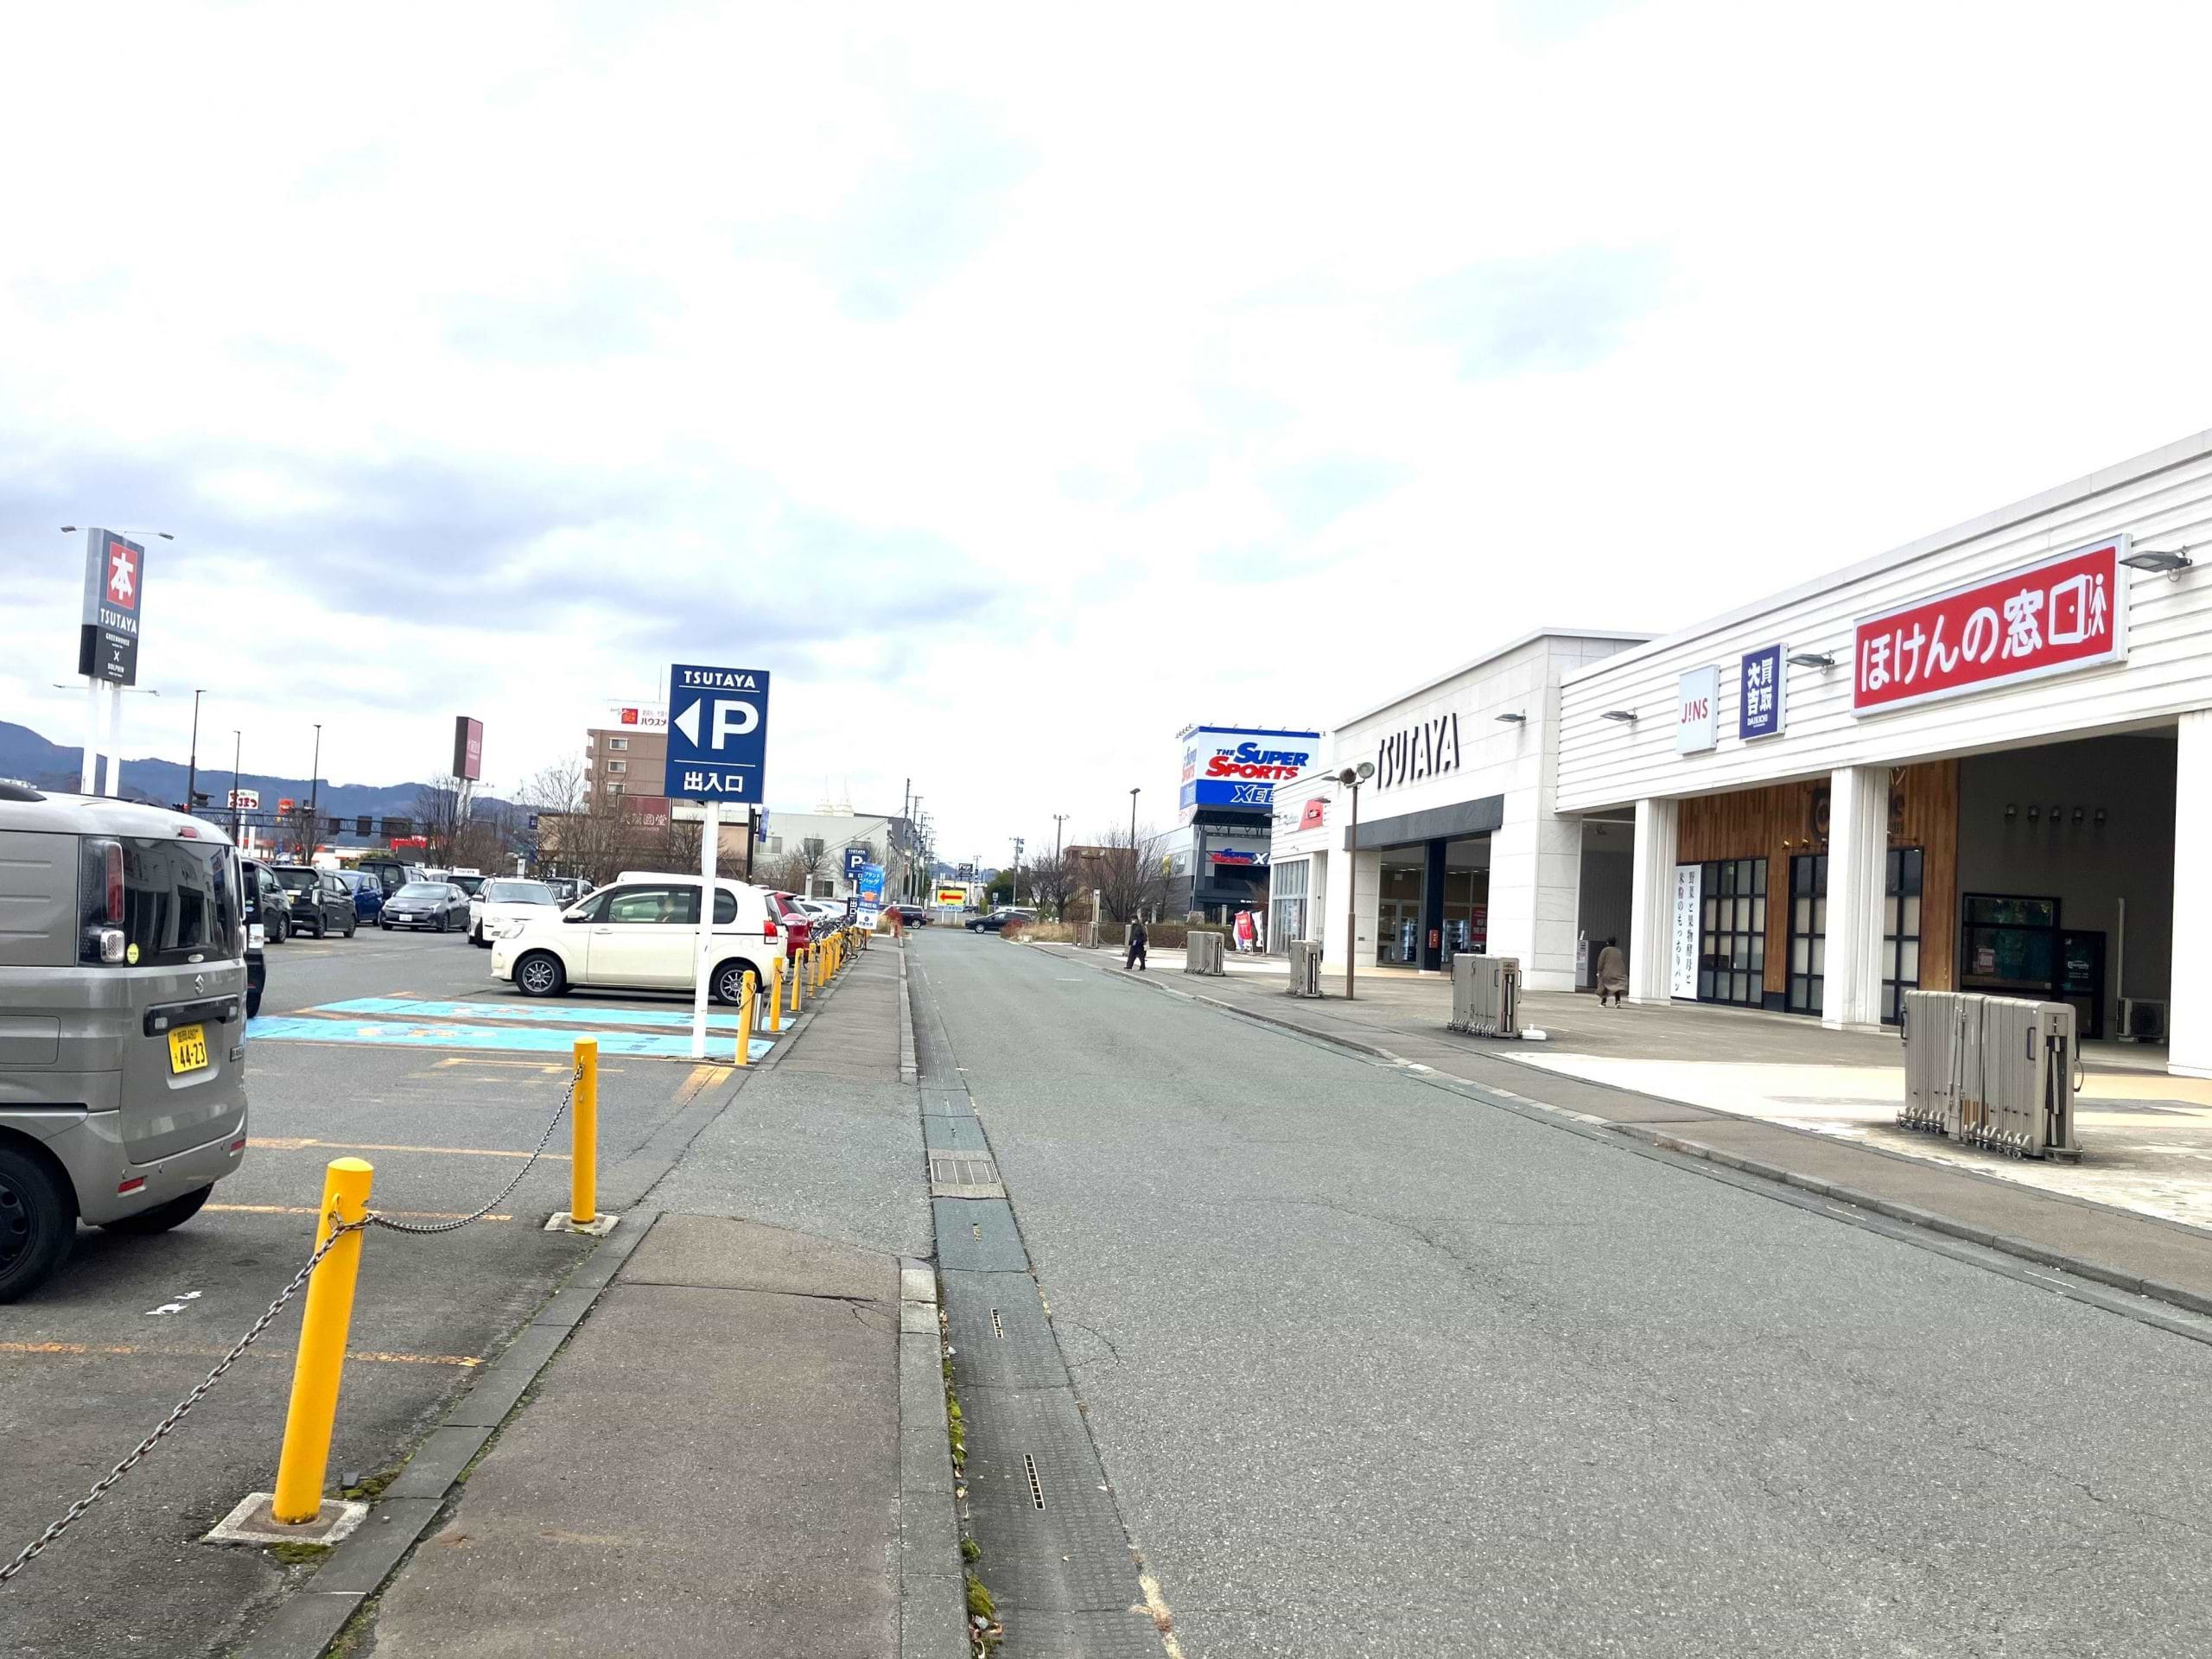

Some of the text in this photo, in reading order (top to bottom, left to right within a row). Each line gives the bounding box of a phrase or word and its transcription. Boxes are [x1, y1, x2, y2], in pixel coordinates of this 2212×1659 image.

[110, 552, 134, 601] 本
[100, 607, 137, 634] TSUTAYA
[683, 671, 756, 689] TSUTAYA
[1747, 662, 1761, 716] 大吉
[1760, 657, 1773, 711] 買取
[711, 699, 760, 750] P
[1205, 756, 1300, 780] SPORTS
[1233, 742, 1309, 766] SUPER
[1376, 712, 1460, 790] TSUTAYA
[683, 771, 743, 793] 出入口
[851, 855, 863, 868] P
[1675, 872, 1685, 991] 米粉のもっちりパン
